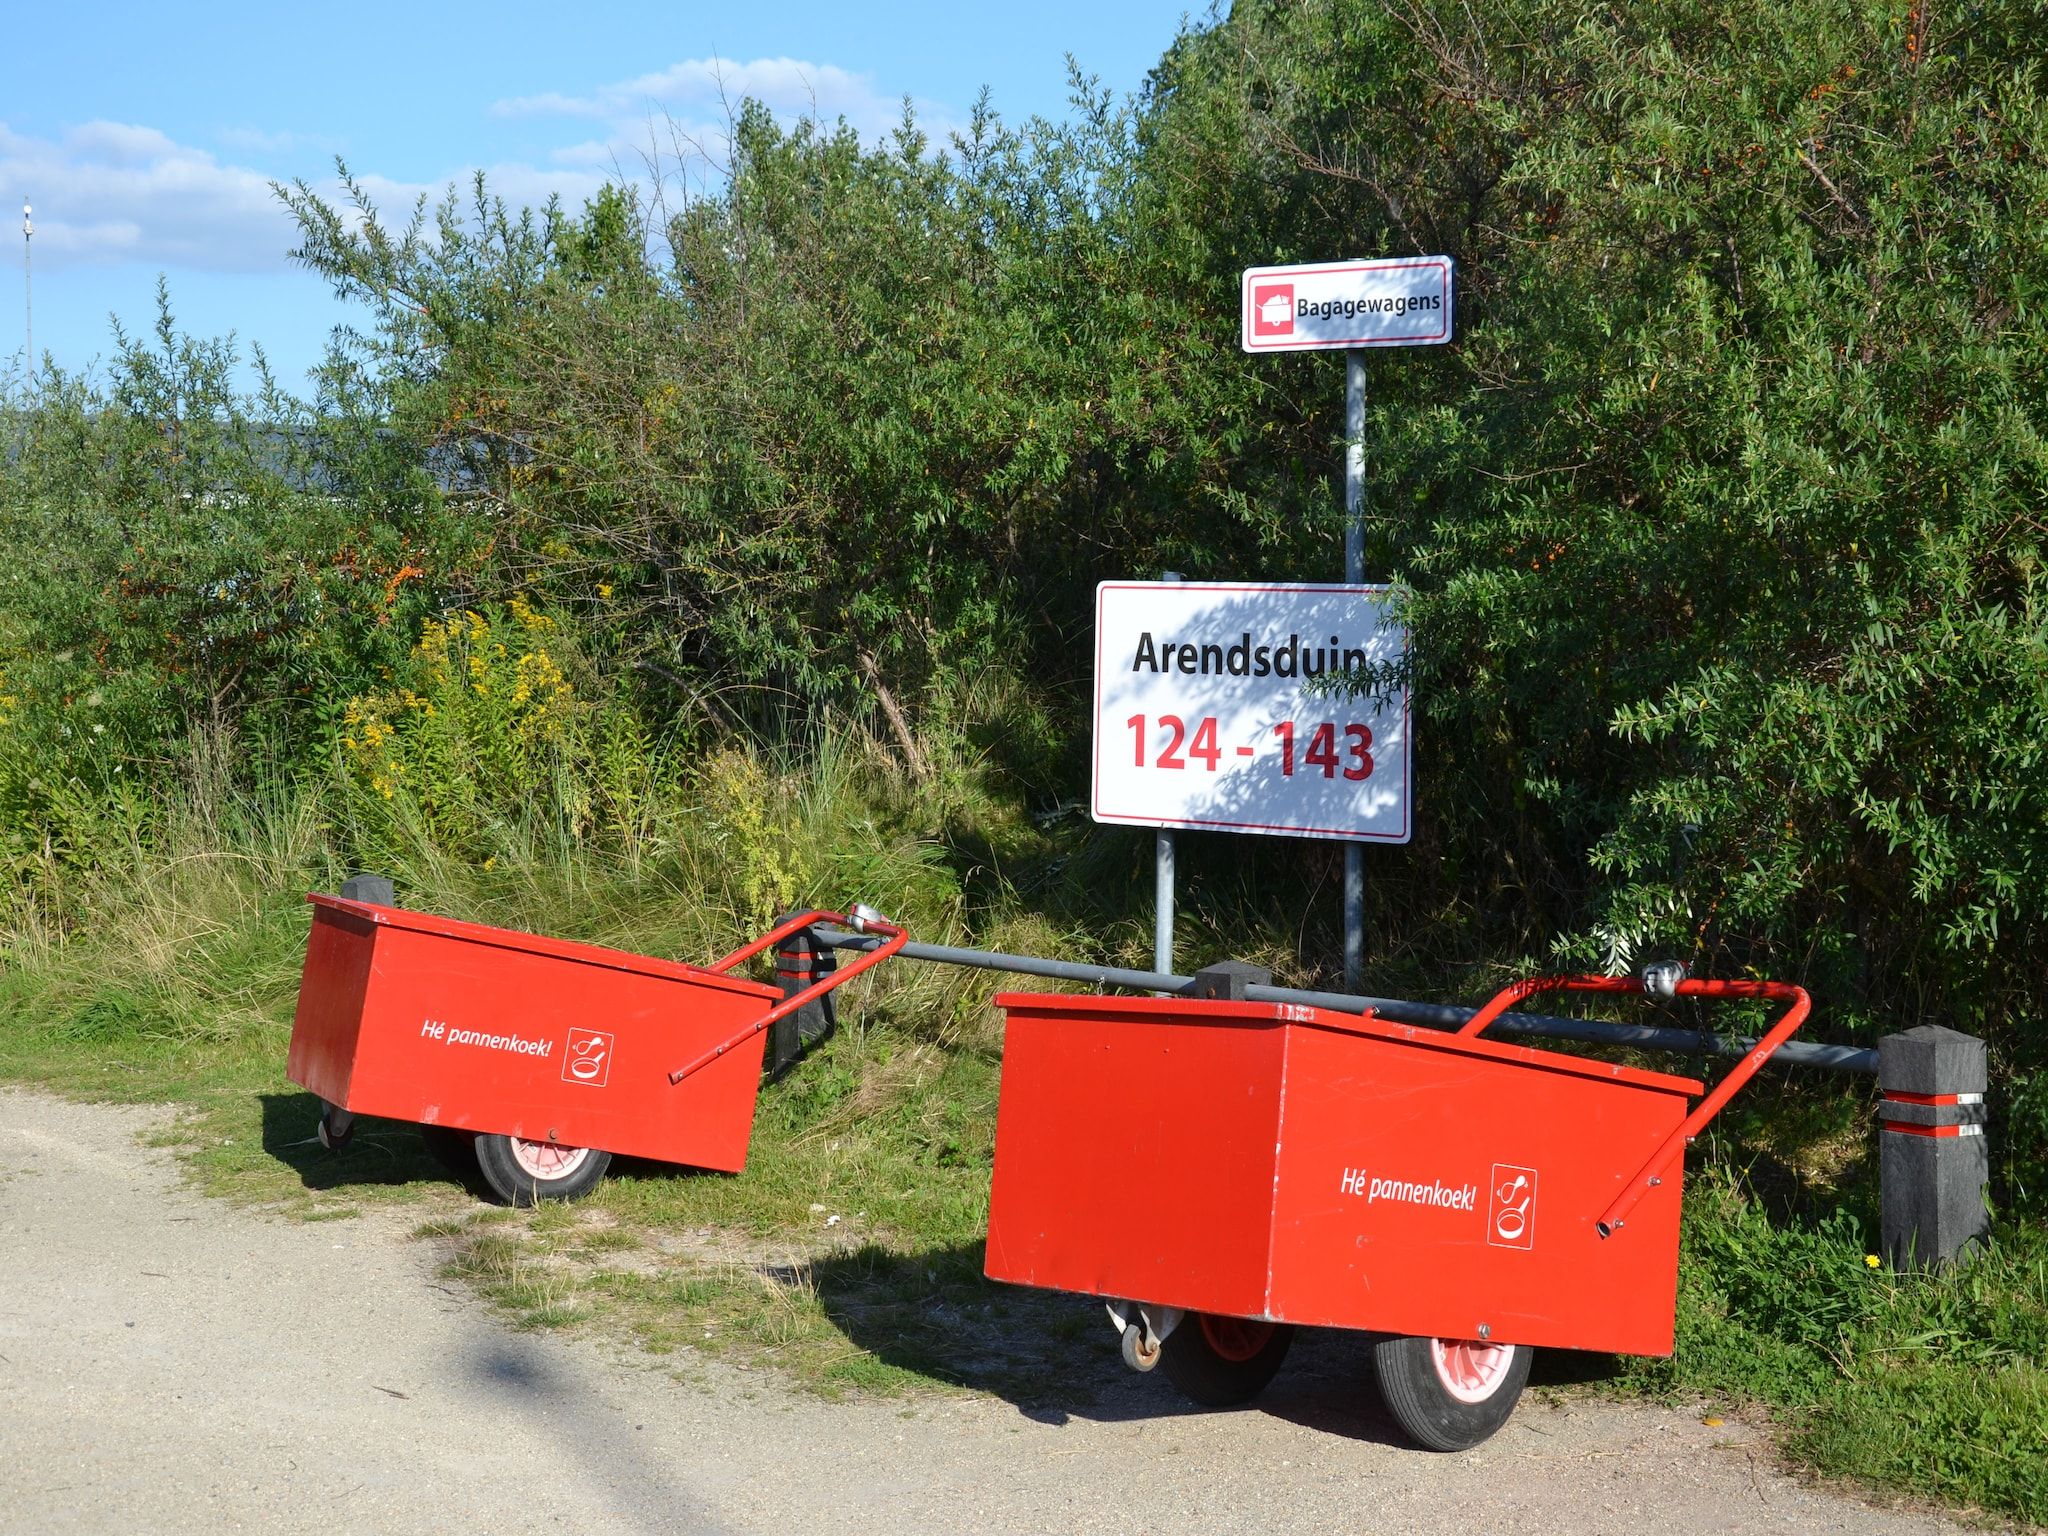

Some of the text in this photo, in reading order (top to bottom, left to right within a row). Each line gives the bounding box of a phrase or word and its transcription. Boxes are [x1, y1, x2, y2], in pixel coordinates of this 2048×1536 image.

[1297, 295, 1441, 321] Bagagewagens
[1132, 632, 1367, 678] Arendsduin
[1127, 713, 1375, 782] 124 - 143
[420, 1019, 553, 1057] Hé pannenkoek!
[1340, 1167, 1477, 1211] Hé pannenkoek!
